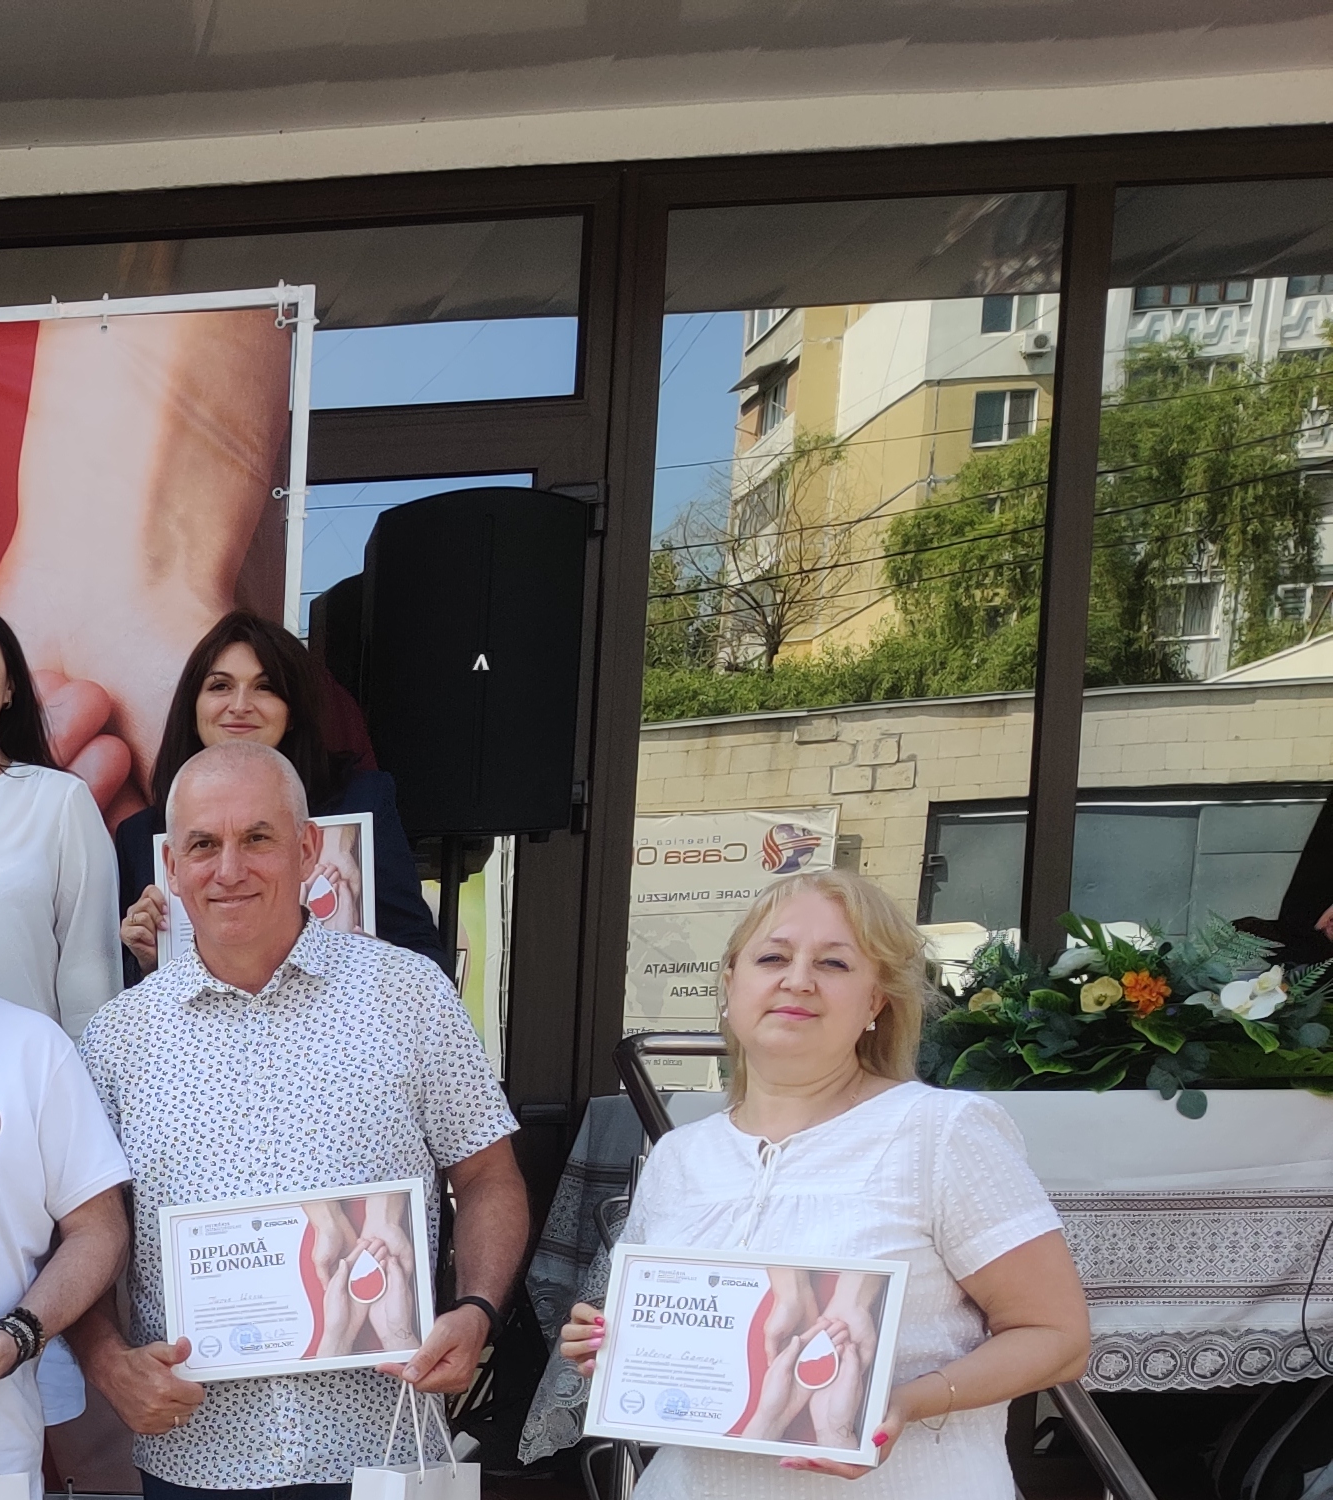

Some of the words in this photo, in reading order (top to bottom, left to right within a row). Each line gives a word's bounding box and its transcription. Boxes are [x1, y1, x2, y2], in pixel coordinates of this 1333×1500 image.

[189, 1237, 267, 1260] DIPLOMĂ
[191, 1262, 213, 1275] DE
[216, 1253, 285, 1272] ONOARE
[634, 1293, 719, 1312] DIPLOMĂ
[631, 1308, 656, 1323] DE
[660, 1311, 735, 1329] ONOARE
